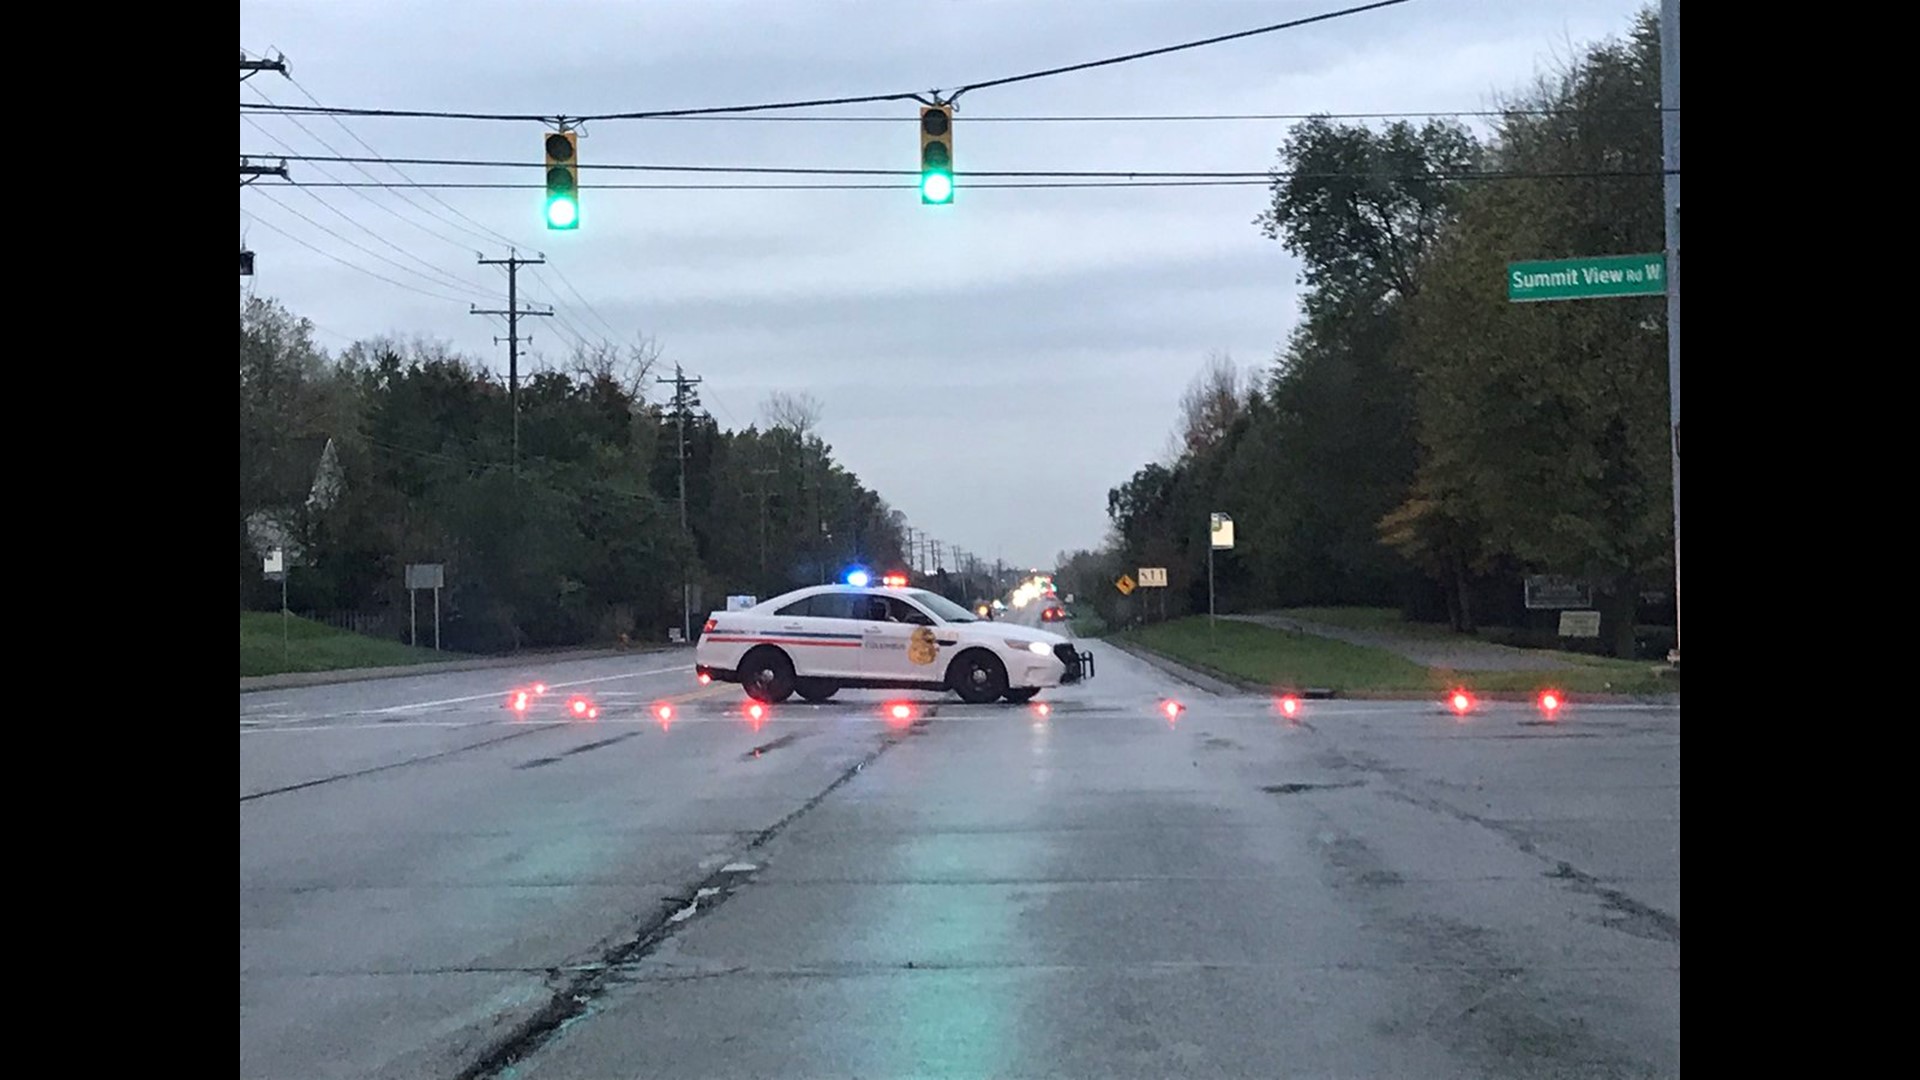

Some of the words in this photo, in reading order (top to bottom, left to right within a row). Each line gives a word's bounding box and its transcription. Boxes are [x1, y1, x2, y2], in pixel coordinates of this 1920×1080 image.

[1513, 269, 1578, 288] Summit
[1582, 267, 1622, 285] View
[1626, 269, 1642, 282] Rd
[1645, 264, 1661, 280] W
